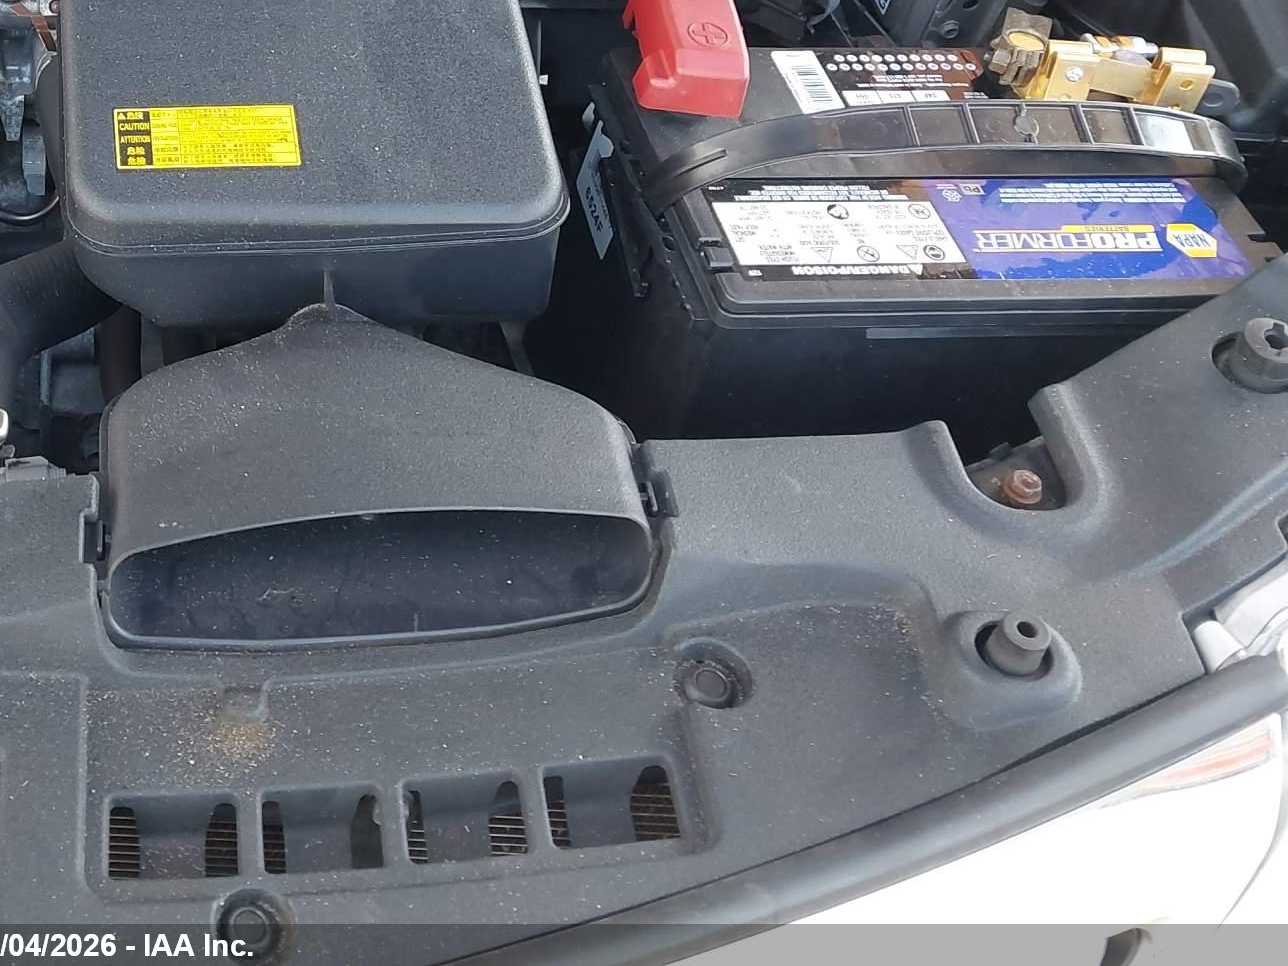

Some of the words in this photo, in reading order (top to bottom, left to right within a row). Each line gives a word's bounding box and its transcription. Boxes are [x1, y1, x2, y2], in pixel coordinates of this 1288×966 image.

[119, 122, 150, 131] CAUTION
[120, 135, 151, 143] ATTENTION
[964, 185, 981, 194] Pb
[975, 232, 1161, 250] PROFORMER
[1172, 233, 1212, 249] NAPA
[791, 264, 910, 276] DANGER/POISON
